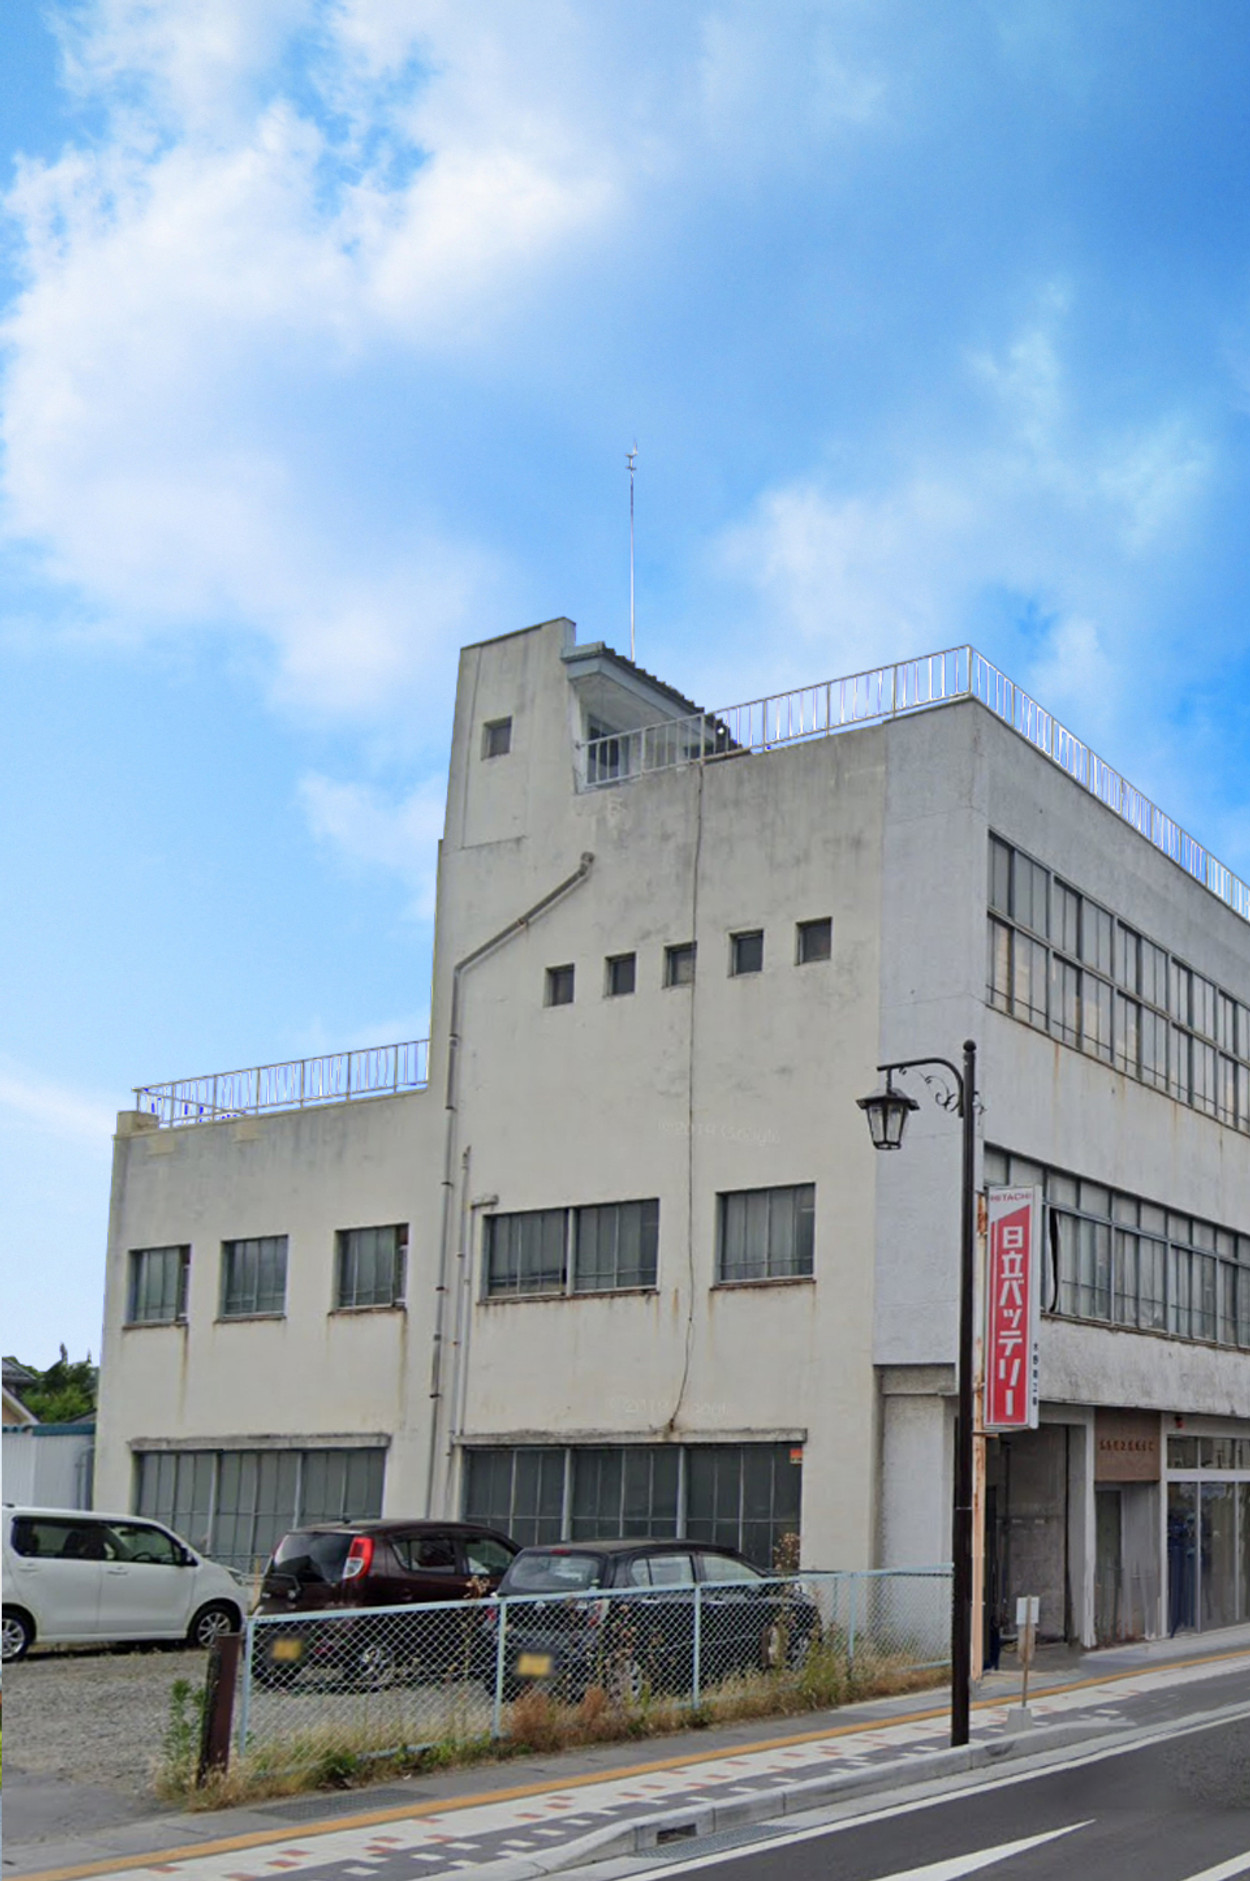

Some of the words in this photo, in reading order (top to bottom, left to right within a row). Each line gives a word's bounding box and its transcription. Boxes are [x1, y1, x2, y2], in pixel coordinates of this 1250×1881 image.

[998, 1226, 1025, 1416] 日立バッテリー
